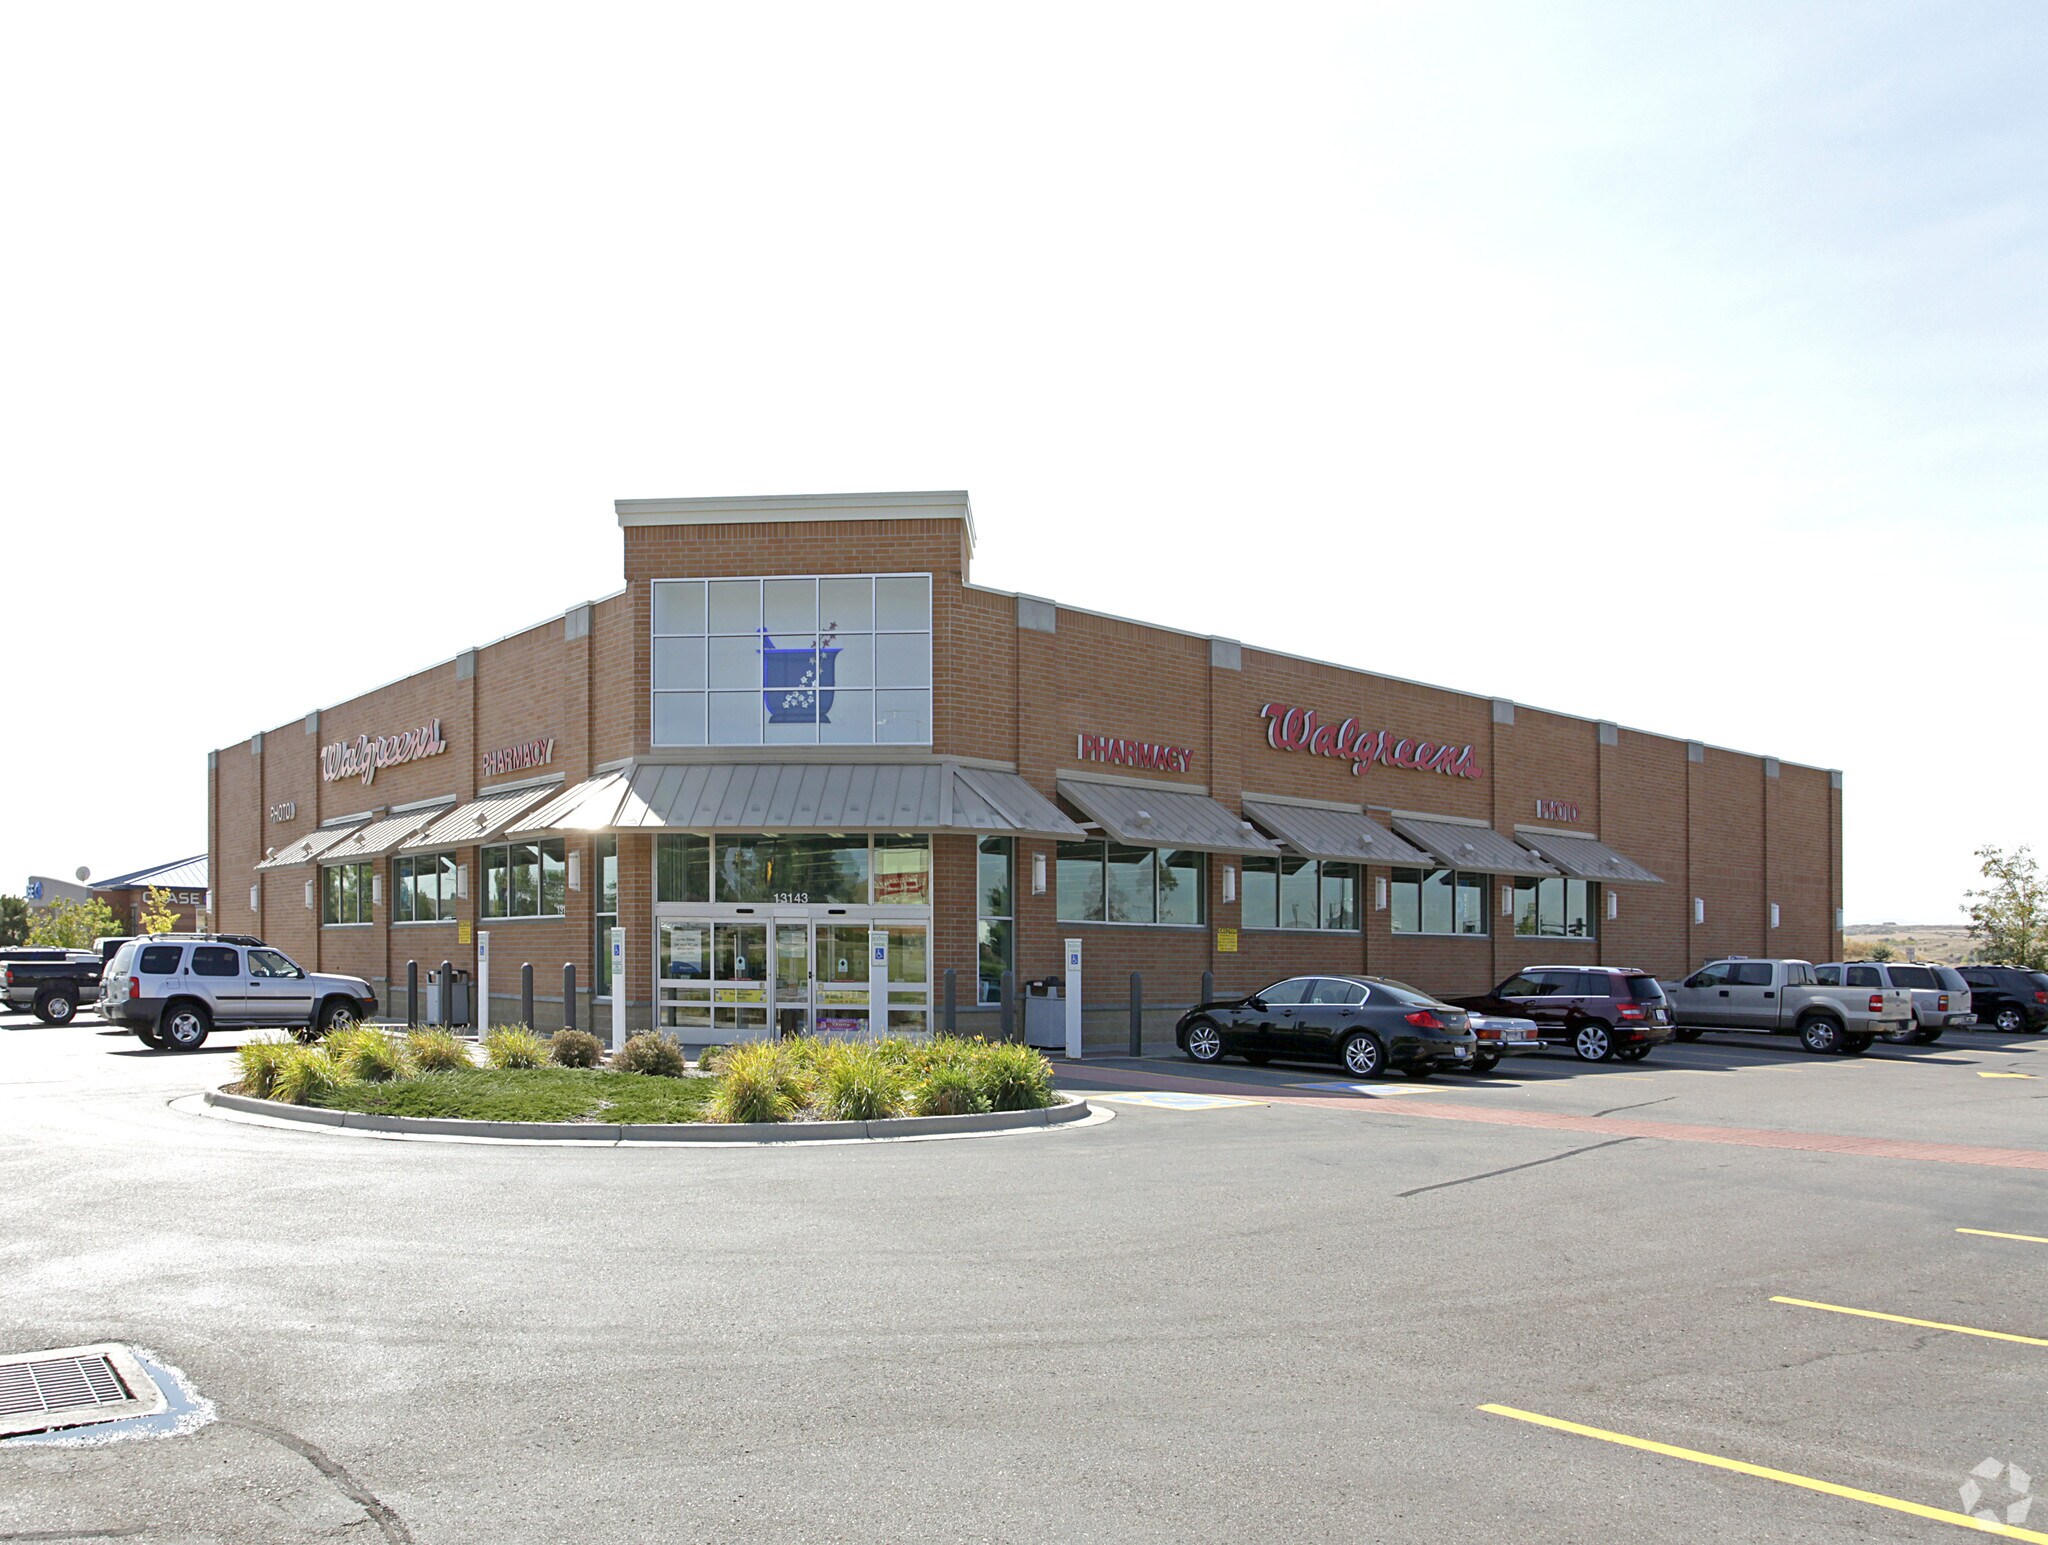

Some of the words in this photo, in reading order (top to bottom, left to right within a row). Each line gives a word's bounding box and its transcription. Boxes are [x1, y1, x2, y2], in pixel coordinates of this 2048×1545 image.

[320, 718, 446, 785] Walgreens
[1077, 733, 1194, 773] PHARMACY
[1260, 703, 1483, 778] Walgreens
[482, 738, 555, 776] PHARMACY
[268, 801, 296, 823] PHOTO
[1536, 799, 1580, 823] PHOTO
[143, 891, 200, 905] CASE
[773, 892, 809, 904] 13143
